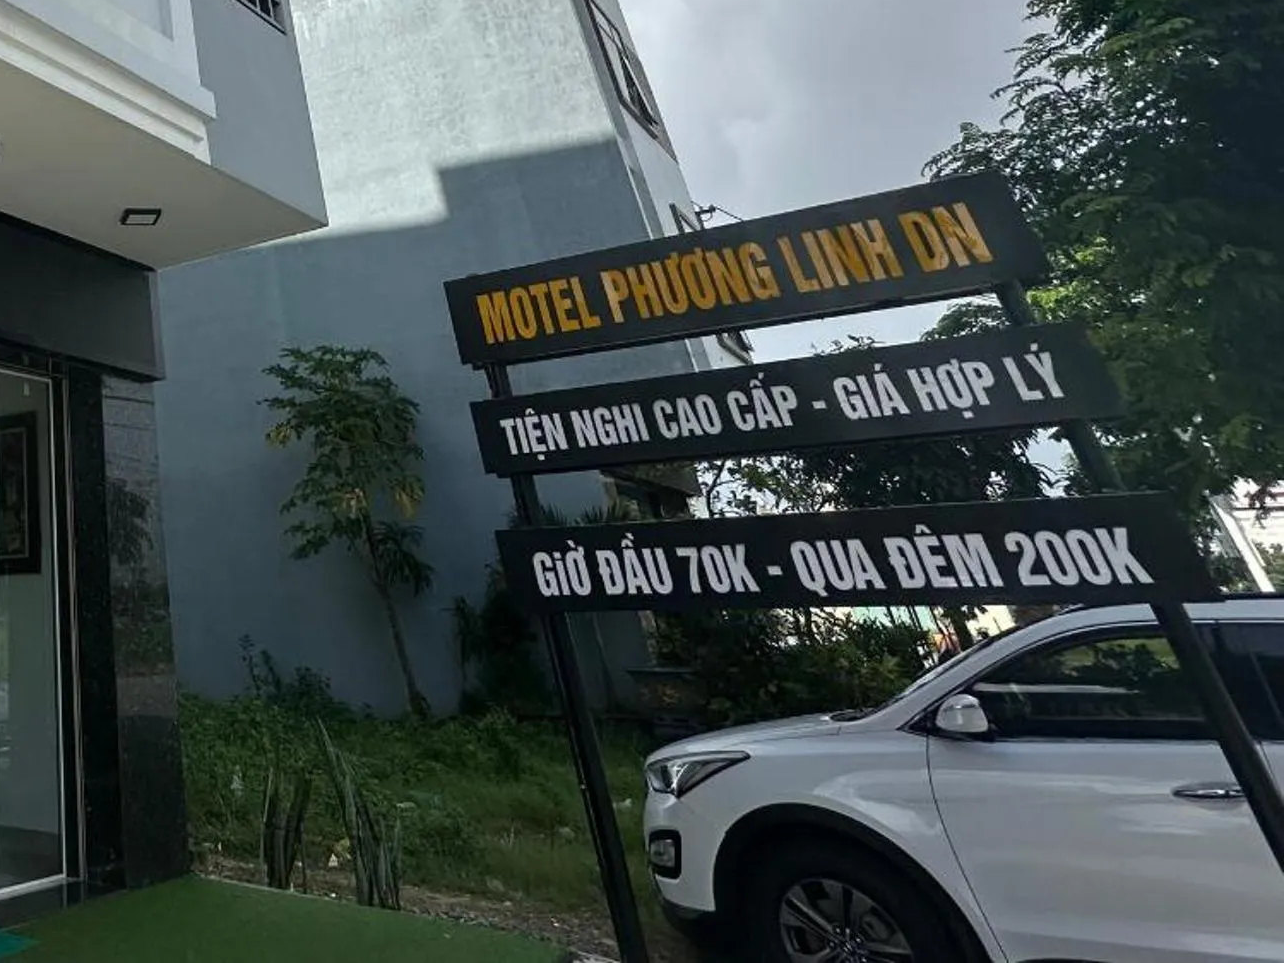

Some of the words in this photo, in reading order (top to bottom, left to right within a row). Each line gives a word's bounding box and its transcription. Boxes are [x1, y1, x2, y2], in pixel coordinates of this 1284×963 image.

[475, 276, 602, 344] MOTEL
[600, 241, 781, 324] PHƯƠNG
[776, 218, 905, 293] LINH
[897, 201, 994, 273] DN
[500, 407, 569, 461] TIỆN
[570, 403, 651, 448] NGHI
[652, 394, 723, 438] CAO
[726, 372, 799, 431] CẤP
[832, 362, 911, 421] GIÁ
[906, 357, 995, 419] HỢP
[1001, 342, 1065, 401] LÝ
[595, 533, 674, 596] ĐẦU
[675, 543, 762, 594] 70K
[789, 538, 888, 597] QUA
[883, 523, 1005, 590] ĐÊM
[1004, 527, 1156, 587] 200K
